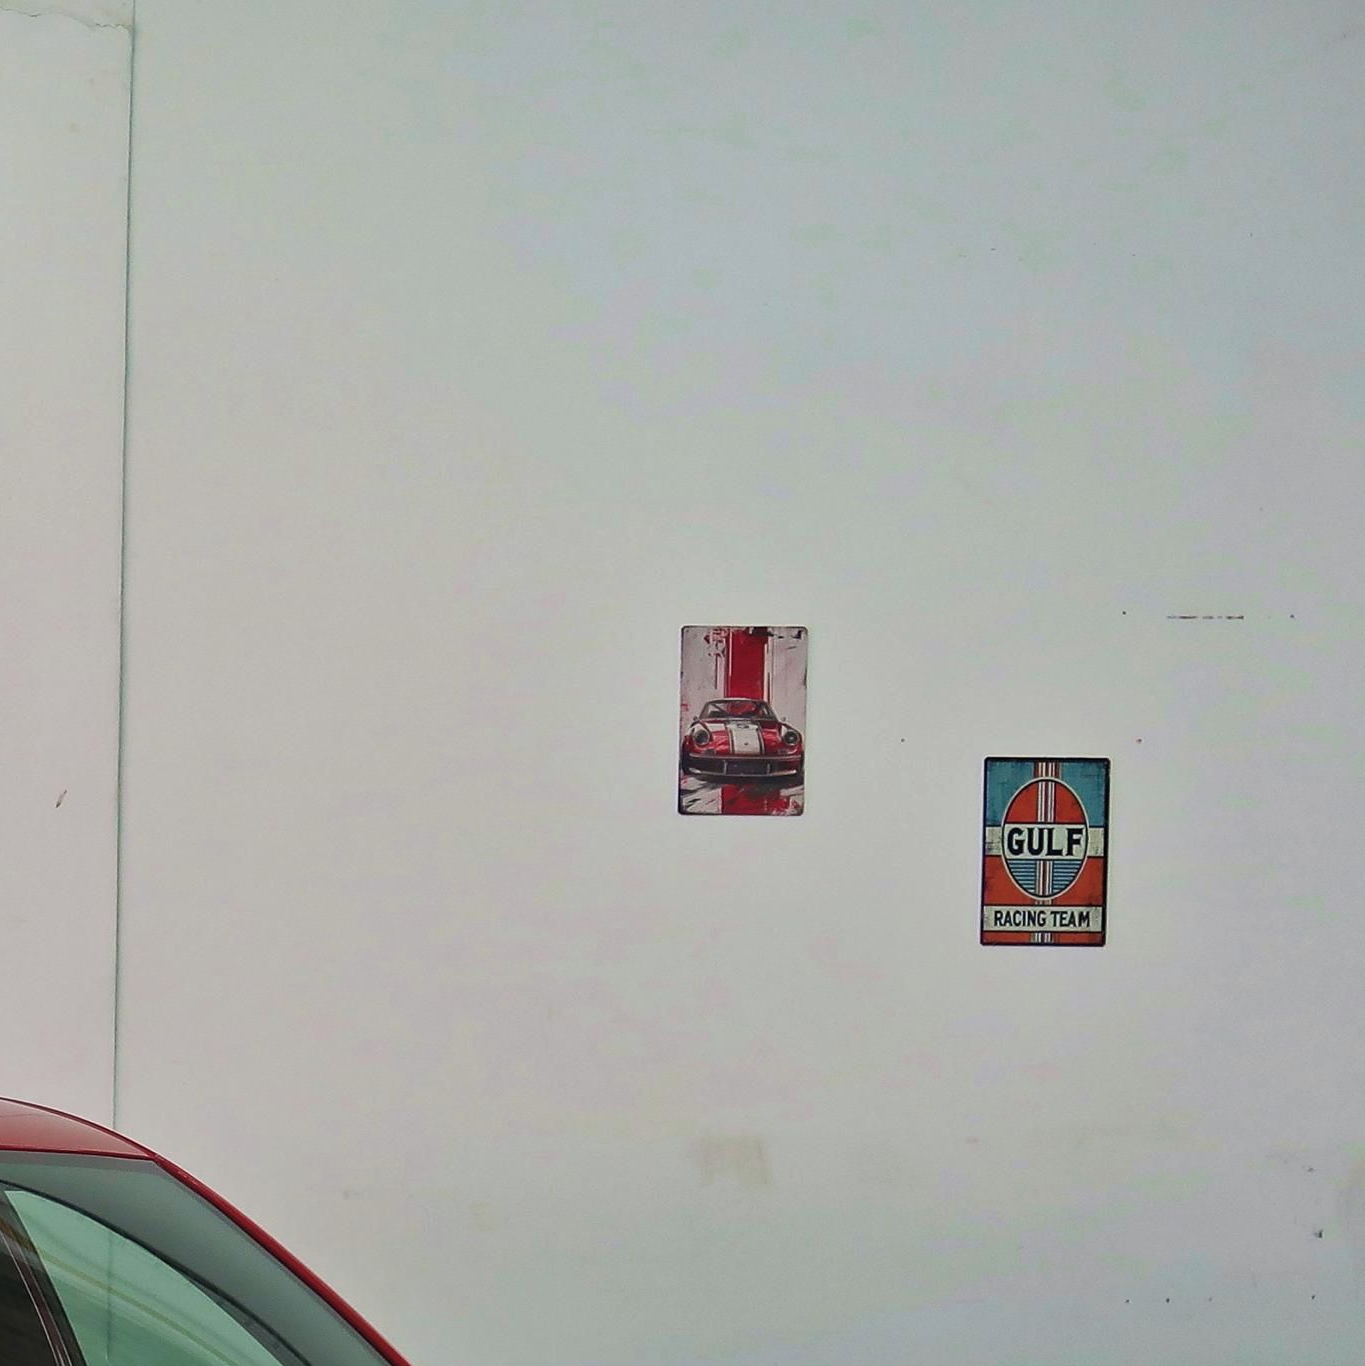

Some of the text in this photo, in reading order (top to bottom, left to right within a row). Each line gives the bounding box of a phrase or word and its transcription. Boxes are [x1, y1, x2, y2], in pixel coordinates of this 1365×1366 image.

[1007, 827, 1084, 856] GULF
[994, 910, 1090, 927] RACING TEAM
